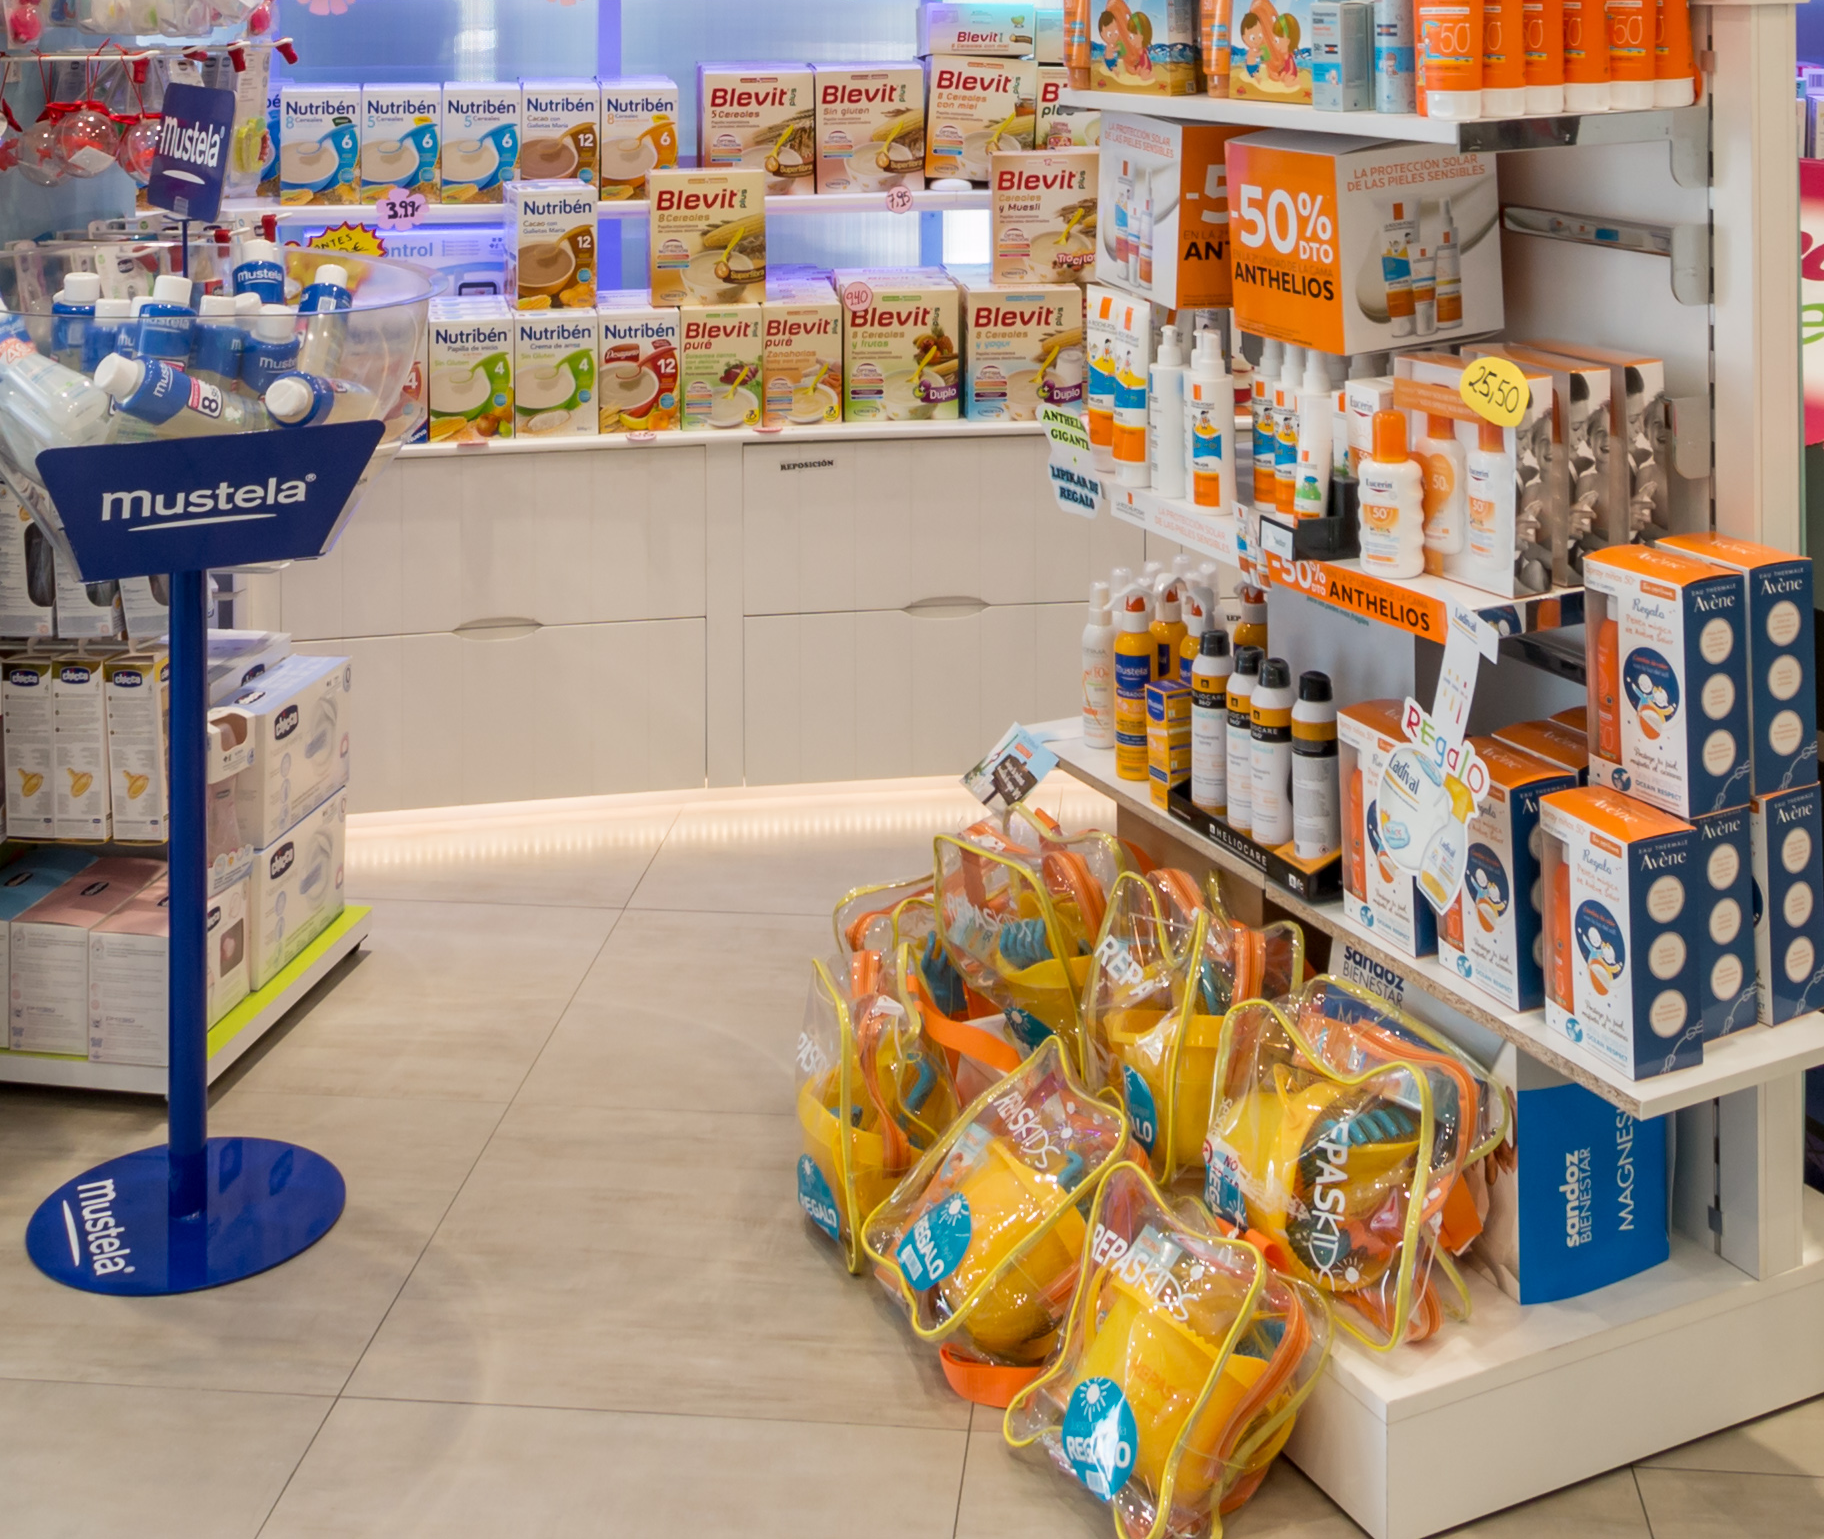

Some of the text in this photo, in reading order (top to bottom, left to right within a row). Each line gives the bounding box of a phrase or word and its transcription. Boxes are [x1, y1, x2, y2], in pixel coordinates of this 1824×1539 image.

[285, 99, 356, 116] Nutribén
[447, 99, 517, 115] Nutribén
[710, 87, 786, 108] Blevit
[1354, 155, 1478, 179] LA PROTECCIÓN SOLAR
[997, 170, 1076, 191] Blevit
[1348, 165, 1485, 192] DE LAS PIELES SENSIBLES
[523, 199, 592, 216] Nutribén
[656, 188, 738, 211] Blevit
[1232, 184, 1332, 254] -50%
[1299, 241, 1333, 263] DTO
[1235, 262, 1334, 301] ANTHELIOS
[435, 328, 508, 345] Nutribén
[604, 322, 676, 339] Nutribén
[930, 388, 957, 400] Duplo
[101, 478, 306, 521] mustela
[1761, 577, 1803, 596] Avène
[1329, 580, 1431, 632] ANTHELIOS
[1694, 594, 1736, 612] Avène
[1216, 827, 1267, 866] HELIOCARE
[1559, 1150, 1580, 1249] sandoz
[1580, 1147, 1592, 1243] BIENESTAR
[77, 1178, 126, 1276] mustela
